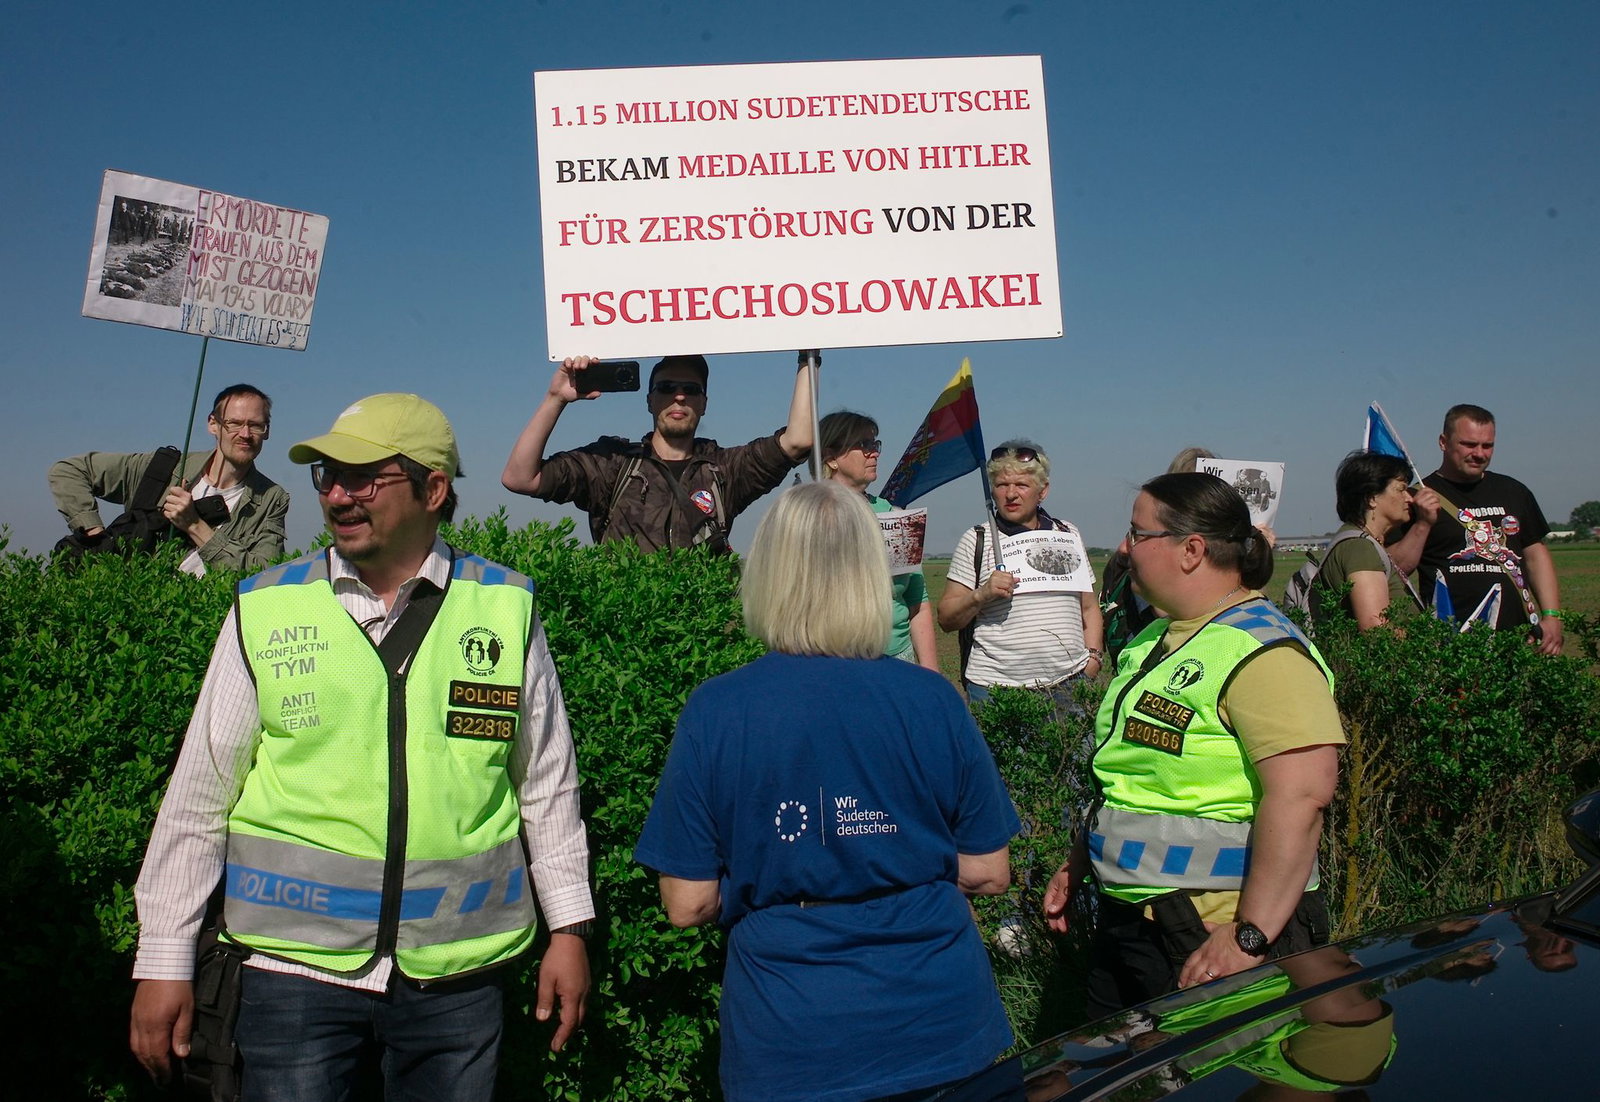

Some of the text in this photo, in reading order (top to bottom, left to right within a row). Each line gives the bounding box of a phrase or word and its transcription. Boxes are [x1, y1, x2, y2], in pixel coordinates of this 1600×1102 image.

[551, 88, 1031, 127] 1.15 MILLION SUDETENDEUTSCHE
[555, 142, 1032, 183] BEKAM MEDAILLE VON HITLER
[196, 190, 314, 245] ERMORDETE
[558, 202, 1037, 247] FÜR ZERSTÖRUNG VON DER
[193, 225, 318, 270] FRAUEN AUS DEM
[187, 250, 318, 297] MIST GEZOGEN
[184, 276, 314, 320] MAI 1945 VOLARY
[561, 272, 1042, 327] TSCHECHOSLOWAKEI
[181, 303, 311, 346] WIE SCHMECKT ES JETZT
[1203, 466, 1223, 477] Wir
[1465, 507, 1505, 517] VOBODU
[1001, 536, 1075, 550] Zeitzeugen leben
[1003, 549, 1022, 559] noch
[267, 625, 318, 647] ANTI
[256, 641, 329, 660] KONFLIKTNÍ
[271, 656, 316, 679] TÝM
[281, 691, 316, 710] ANTI
[453, 686, 518, 706] POLICIE
[280, 706, 317, 718] CONFLICT
[1143, 693, 1192, 722] POLICIE
[281, 714, 321, 731] TEAM
[452, 716, 512, 738] 322818
[1127, 722, 1180, 750] 320566
[834, 796, 858, 809] Wir
[836, 809, 889, 823] Sudeten-
[836, 822, 897, 836] deutschen
[237, 871, 328, 911] POLICIE
